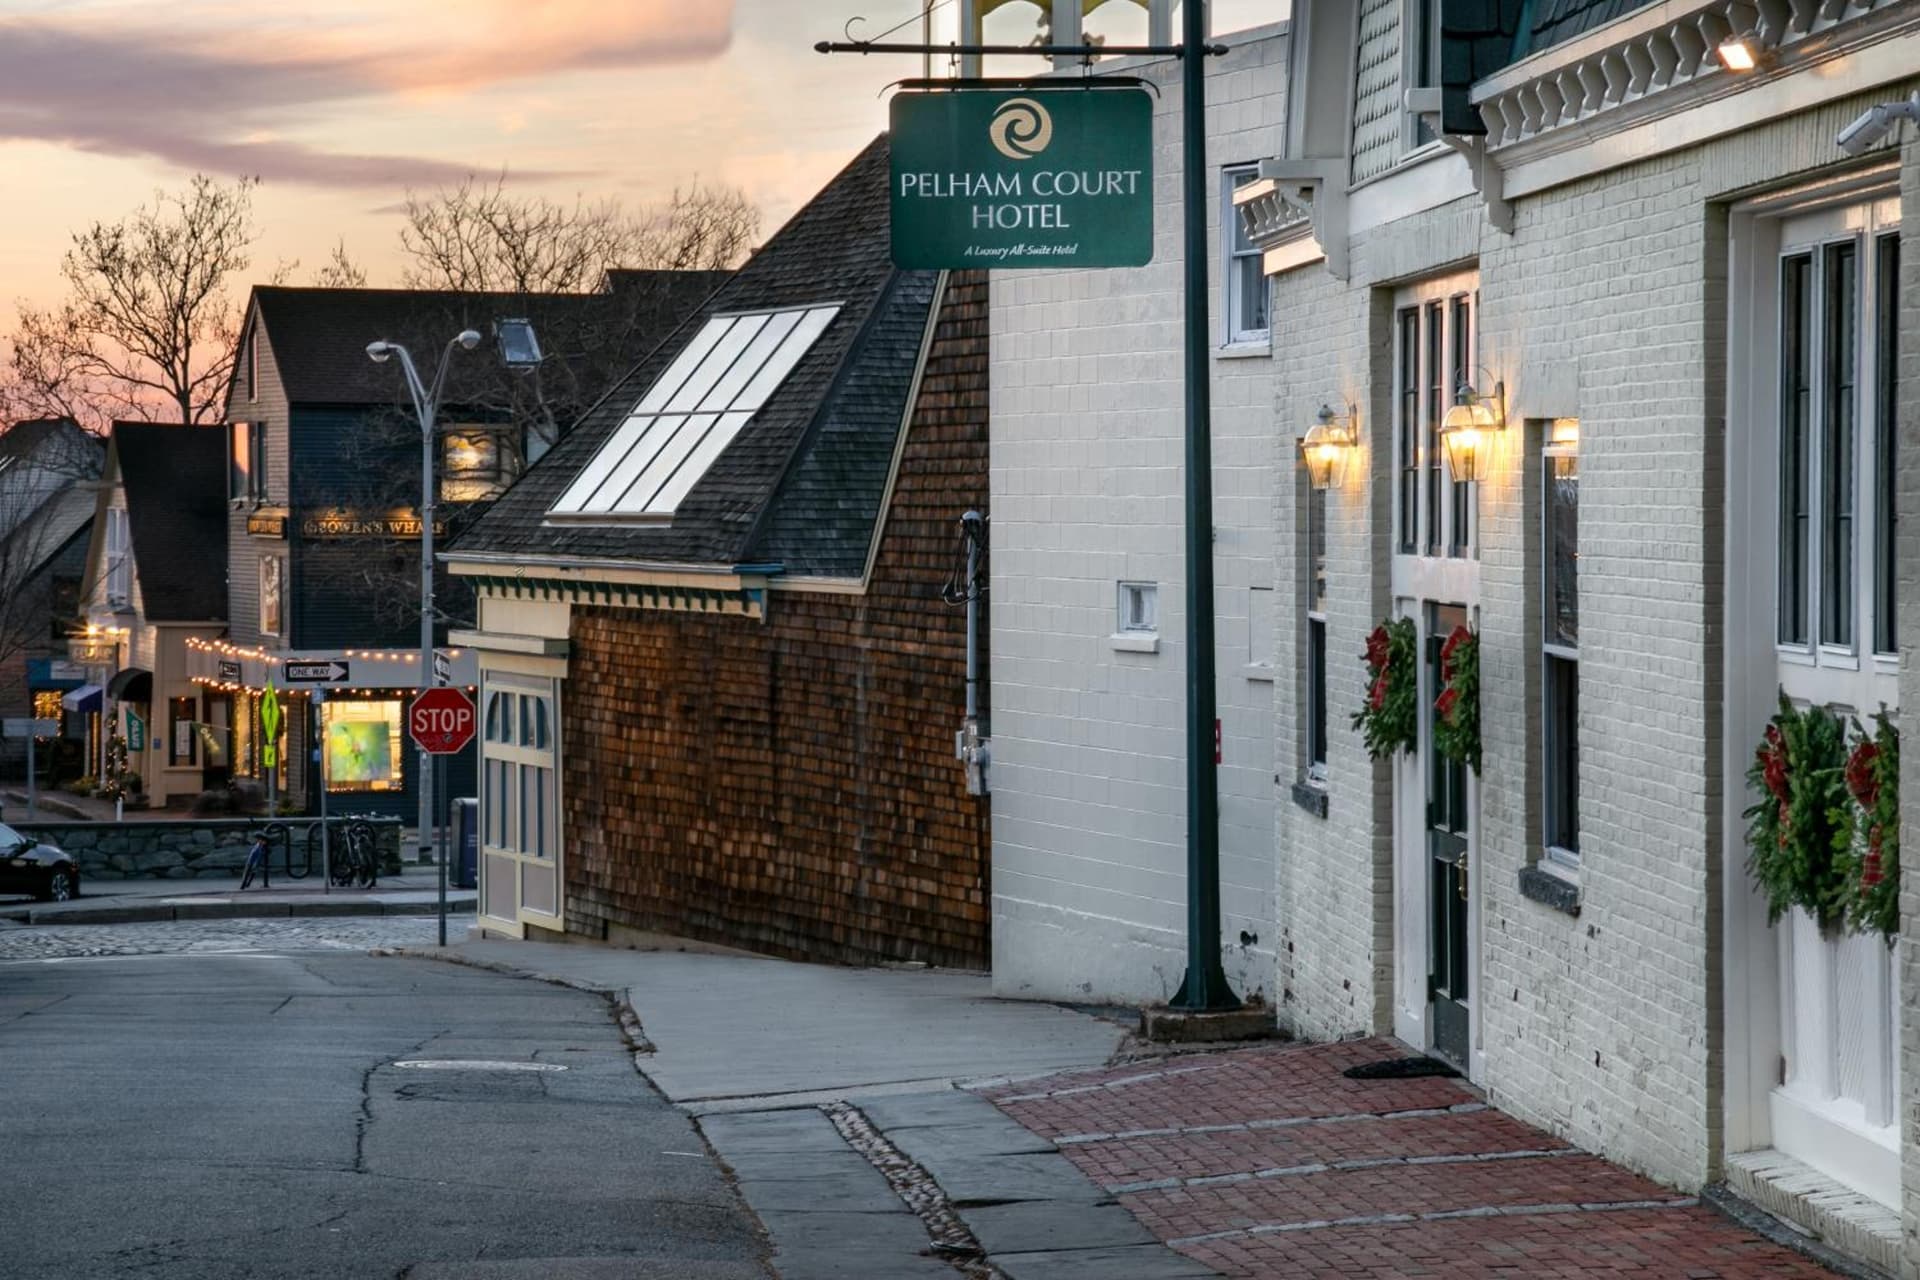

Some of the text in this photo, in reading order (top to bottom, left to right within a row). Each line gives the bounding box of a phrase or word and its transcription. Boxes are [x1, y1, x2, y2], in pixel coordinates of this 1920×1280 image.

[901, 170, 1142, 197] PELHAM COURT
[972, 203, 1070, 229] HOTEL
[964, 246, 973, 256] A
[974, 245, 1009, 260] Luxury
[1052, 243, 1078, 255] Hotel
[291, 667, 330, 677] ONE WAY
[414, 708, 471, 733] STOP
